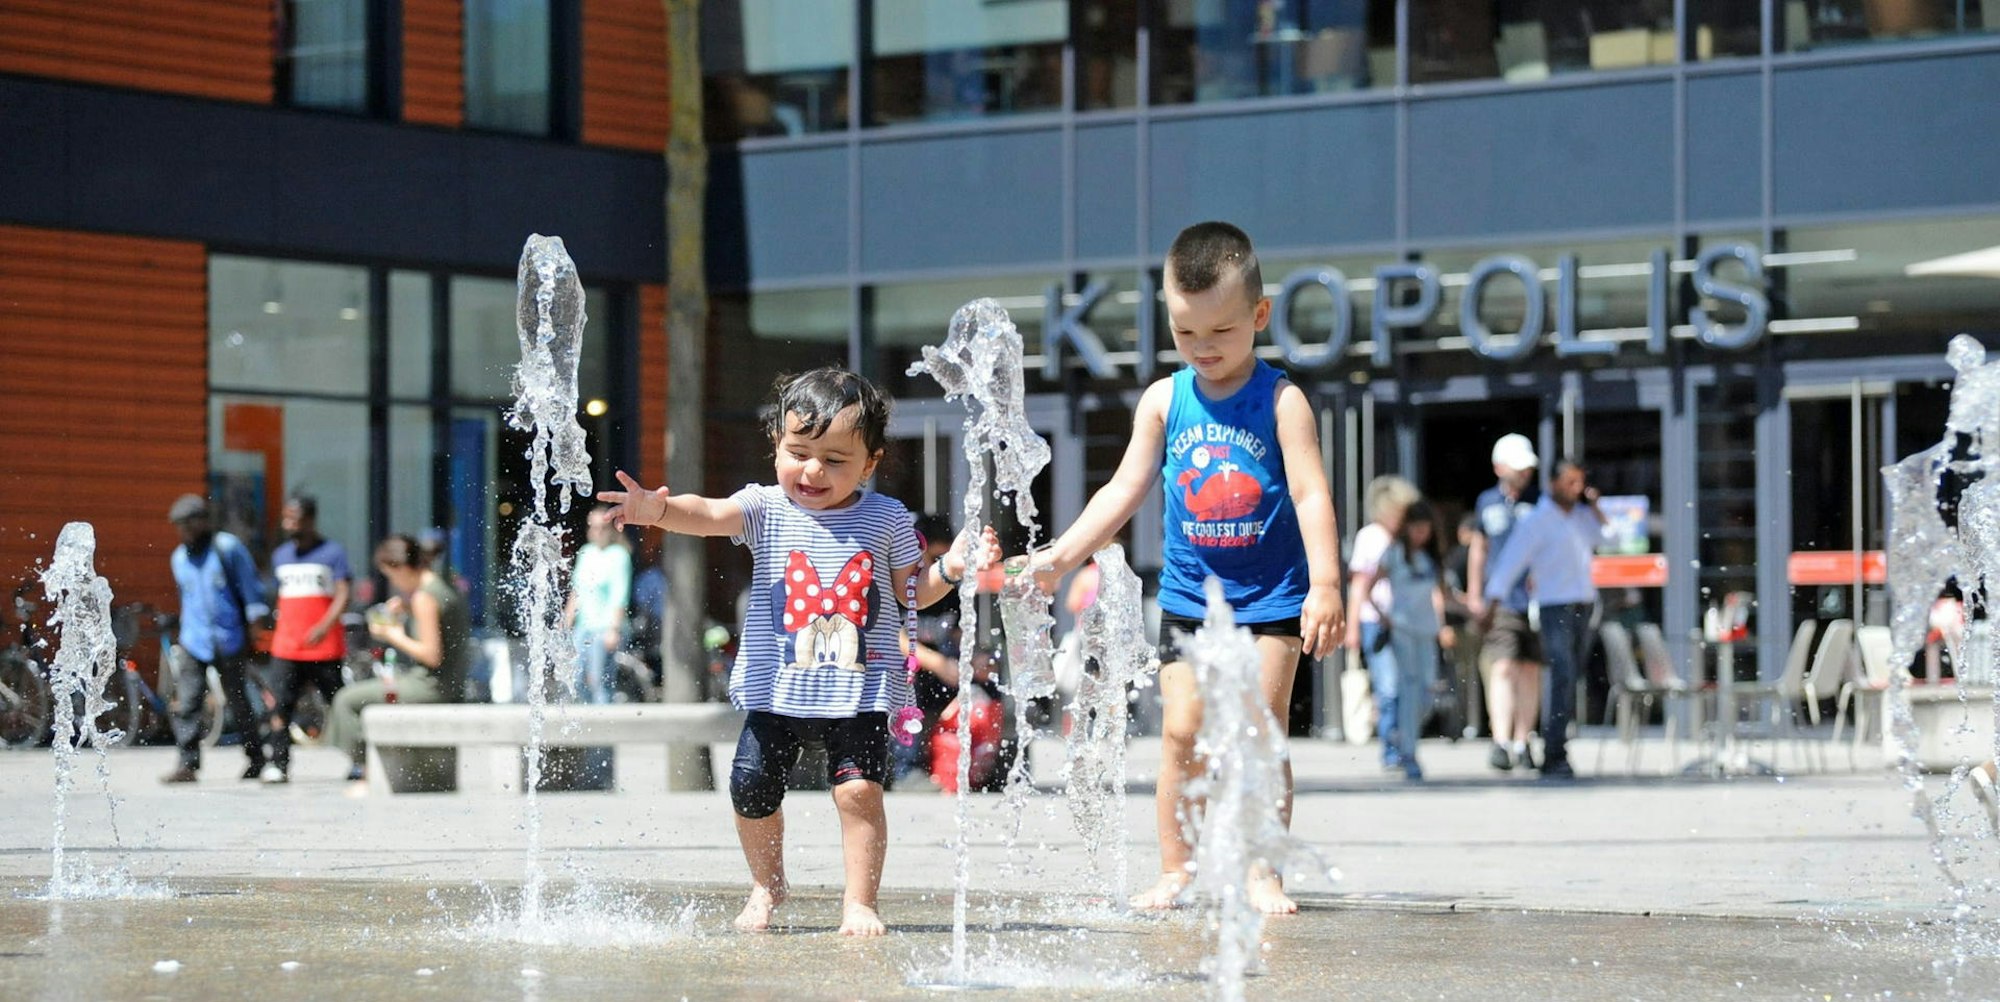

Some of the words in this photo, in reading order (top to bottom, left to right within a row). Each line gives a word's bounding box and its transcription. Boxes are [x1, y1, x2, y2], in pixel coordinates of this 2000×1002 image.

[1042, 243, 1769, 383] KIOPOLIS
[1206, 423, 1267, 462] EXPLORER
[1195, 522, 1236, 539] COOLEST
[1238, 520, 1264, 537] DUDE
